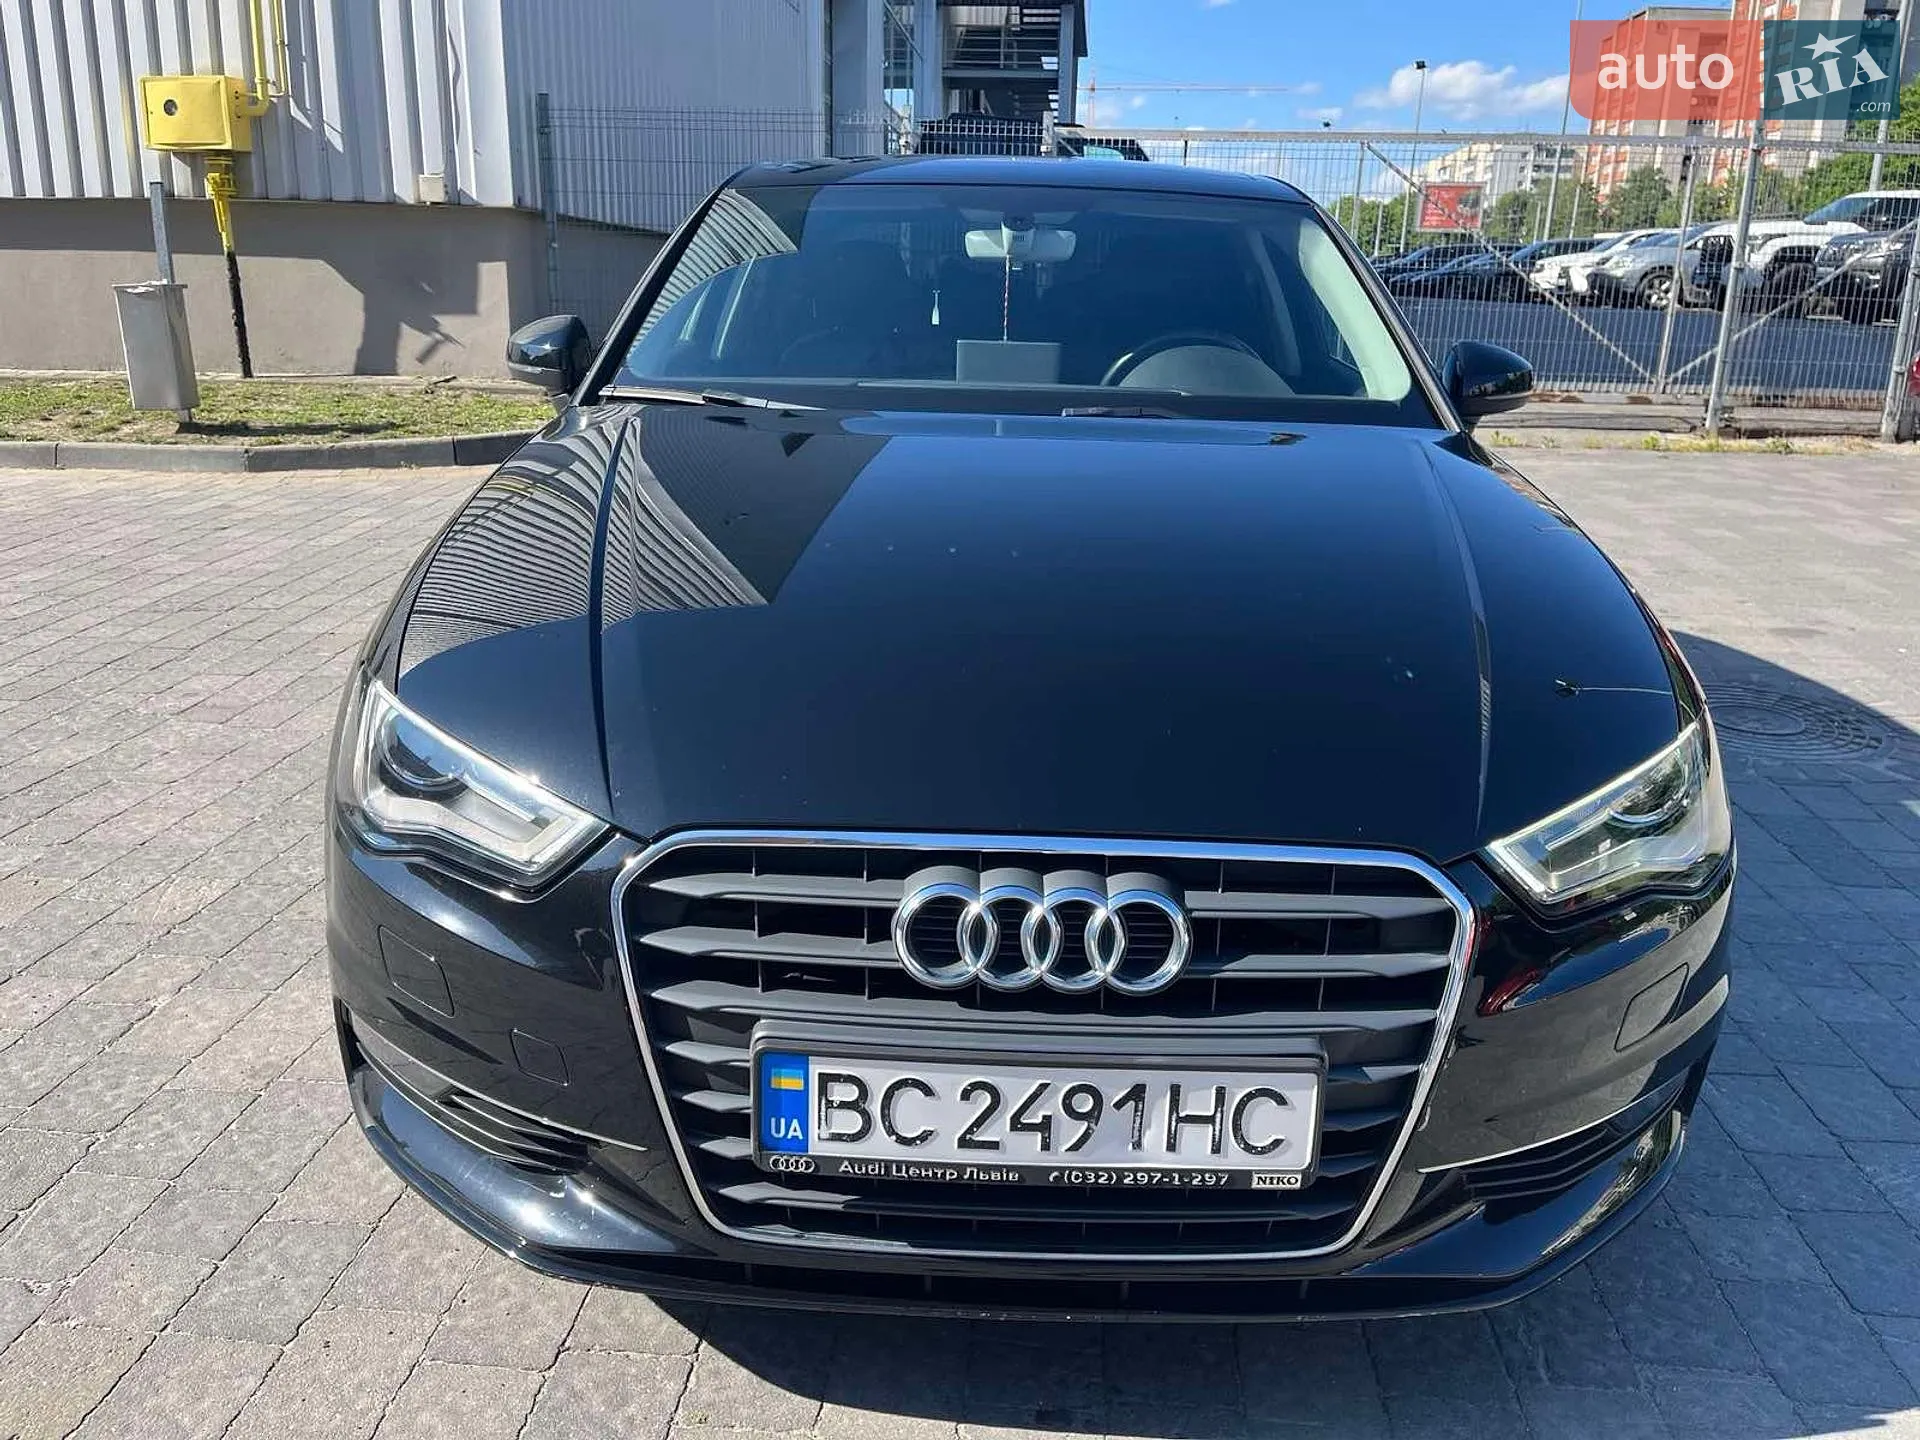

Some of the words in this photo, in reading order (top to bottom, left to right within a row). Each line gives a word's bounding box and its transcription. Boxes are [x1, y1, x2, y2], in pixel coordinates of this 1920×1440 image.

[770, 1117, 804, 1140] UA
[838, 1160, 885, 1176] Audi
[892, 1164, 958, 1181] Центр
[963, 1167, 1019, 1181] Львів
[1123, 1172, 1229, 1186] 297-1-297
[1254, 1176, 1299, 1187] NIKO
